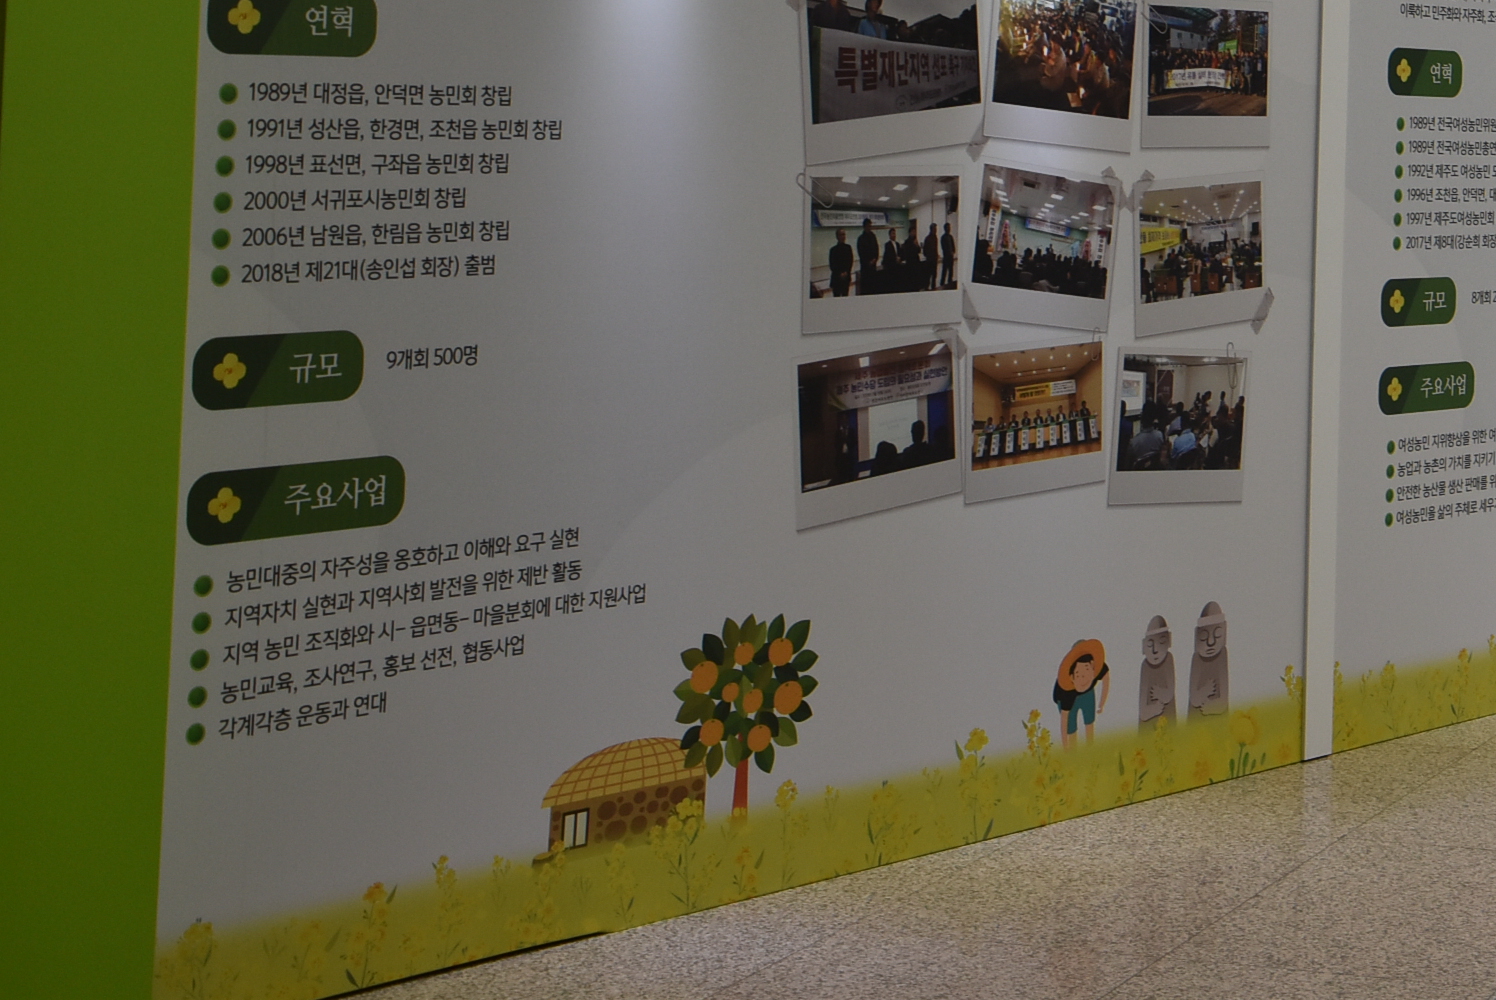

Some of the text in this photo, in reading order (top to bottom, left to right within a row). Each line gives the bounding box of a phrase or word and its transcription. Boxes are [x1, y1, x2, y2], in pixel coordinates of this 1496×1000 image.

[305, 5, 354, 37] 연혁
[835, 47, 930, 94] 특별재난지역
[932, 53, 947, 80] 선포
[1430, 63, 1453, 84] 연혁
[248, 82, 308, 104] 1989년
[374, 84, 424, 105] 안덕면
[428, 85, 477, 106] 농민회
[480, 85, 512, 106] 창립
[247, 118, 303, 139] 1991년
[428, 119, 479, 140] 조천읍
[481, 120, 529, 140] 농민회
[531, 120, 563, 140] 창립
[1409, 117, 1436, 131] 1989년
[1408, 141, 1435, 154] 1989년
[245, 154, 305, 175] 1998년
[370, 154, 423, 175] 구좌읍
[425, 153, 475, 175] 농민회
[477, 153, 510, 174] 창립
[1407, 164, 1434, 178] 1992년
[1434, 164, 1460, 178] 제주도
[1460, 165, 1491, 179] 여성농민
[243, 187, 467, 211] 2000년 서귀포시농민회 창립
[1406, 188, 1434, 202] 1996년
[1406, 212, 1433, 226] 1997년
[1433, 211, 1495, 226] 제주도여성농민회
[241, 225, 305, 247] 2006년
[371, 223, 423, 245] 한림읍
[425, 221, 475, 243] 농민회
[478, 220, 510, 241] 창립
[1405, 235, 1433, 249] 2017년
[241, 262, 301, 283] 2018년
[420, 256, 460, 277] 회장)
[463, 255, 496, 276] 출범
[1422, 292, 1447, 311] 규모
[1471, 290, 1492, 304] 8개회
[289, 353, 343, 383] 규모
[386, 344, 479, 370] 9개회 500명
[283, 475, 386, 515] 주요사업
[226, 527, 580, 593] 농민대중의 자주성을 옹호하고 이해와 요구 실현
[224, 560, 583, 628] 지역자치 실현과 지역사회 발전을 위한 제반 활동
[382, 653, 417, 677] 홍보
[462, 634, 525, 664] 협동사업
[218, 691, 387, 739] 각계각층 운동과 연대
